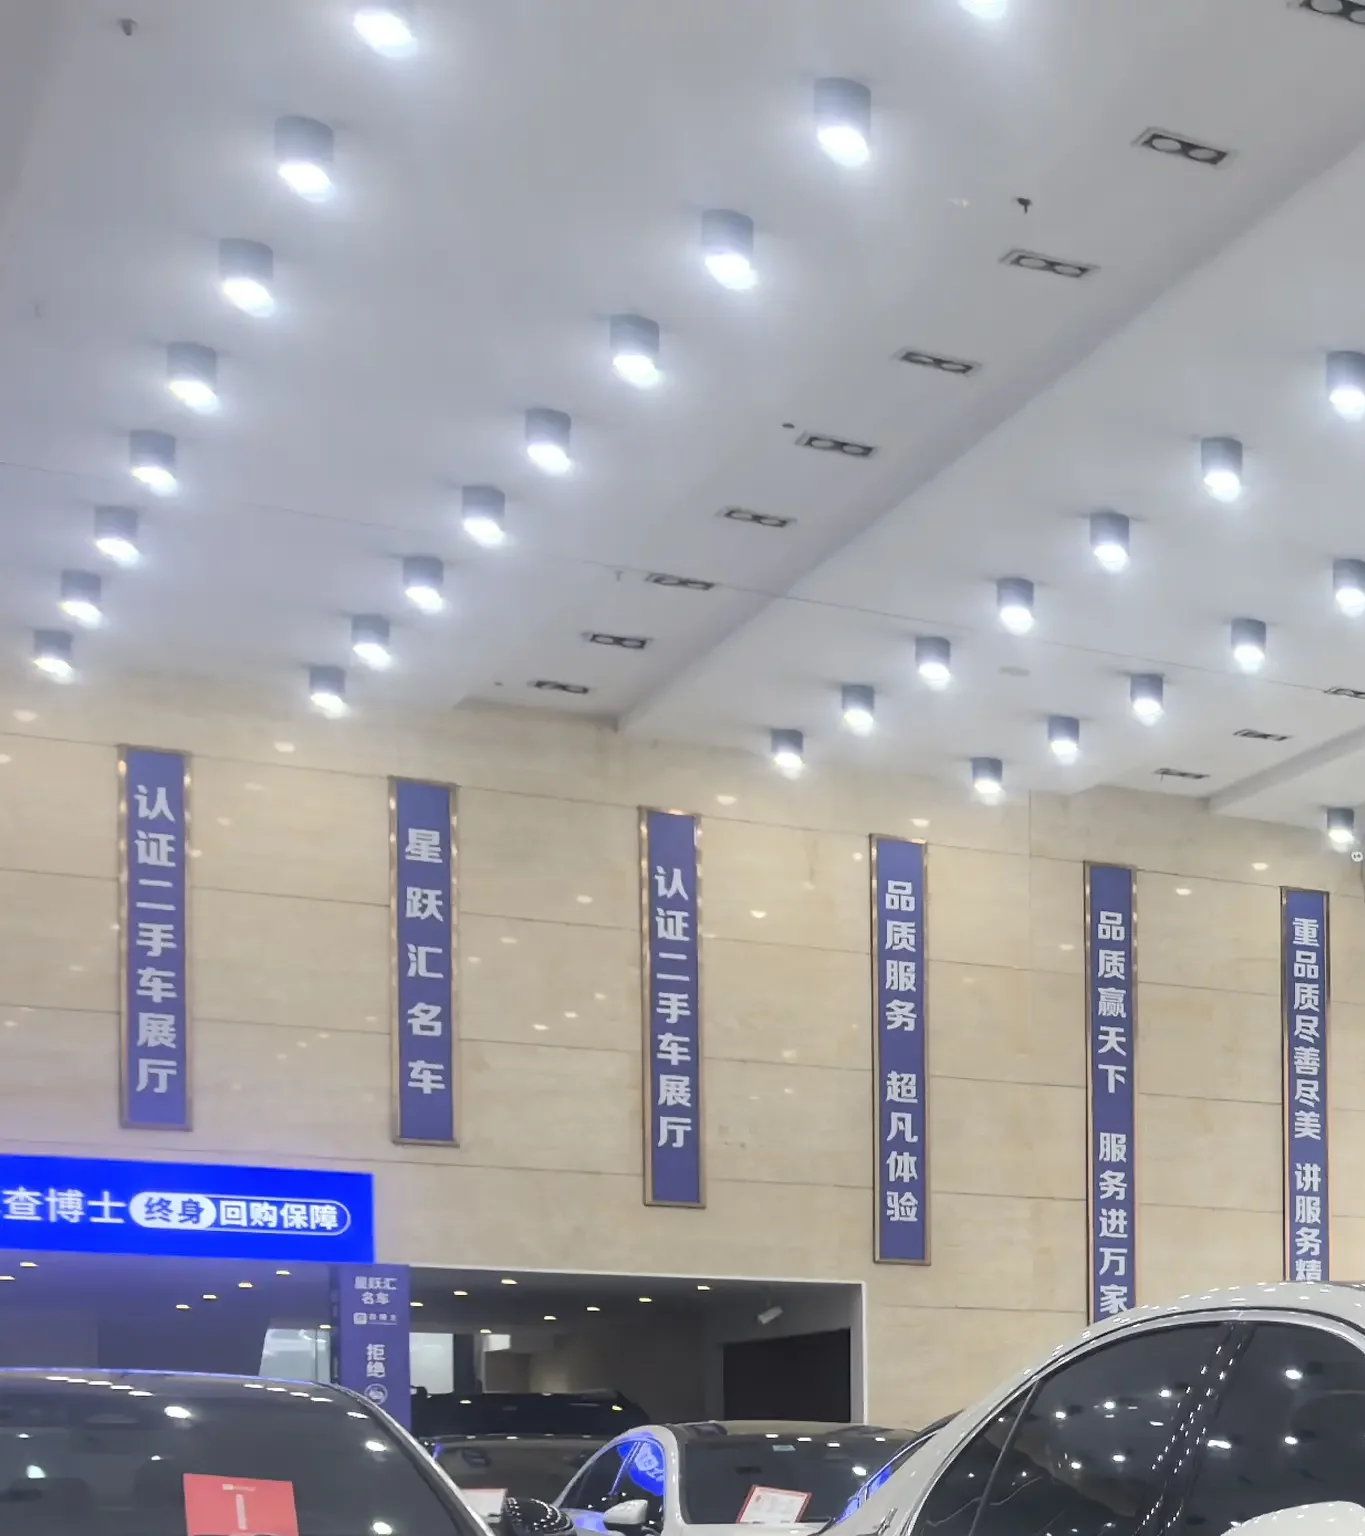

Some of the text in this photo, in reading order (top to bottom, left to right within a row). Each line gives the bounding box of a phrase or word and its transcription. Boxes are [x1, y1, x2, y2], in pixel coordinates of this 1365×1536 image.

[134, 784, 178, 1095] 认证二手车展厅
[404, 828, 446, 1095] 星跃汇名车
[654, 866, 693, 1150] 认证二手车展厅
[885, 880, 919, 1223] 品质服务 超凡体验
[1292, 918, 1321, 1141] 重品质尽善尽美
[219, 1199, 339, 1231] 回购保障
[1097, 911, 1128, 1315] 品质赢天下 服务进万家
